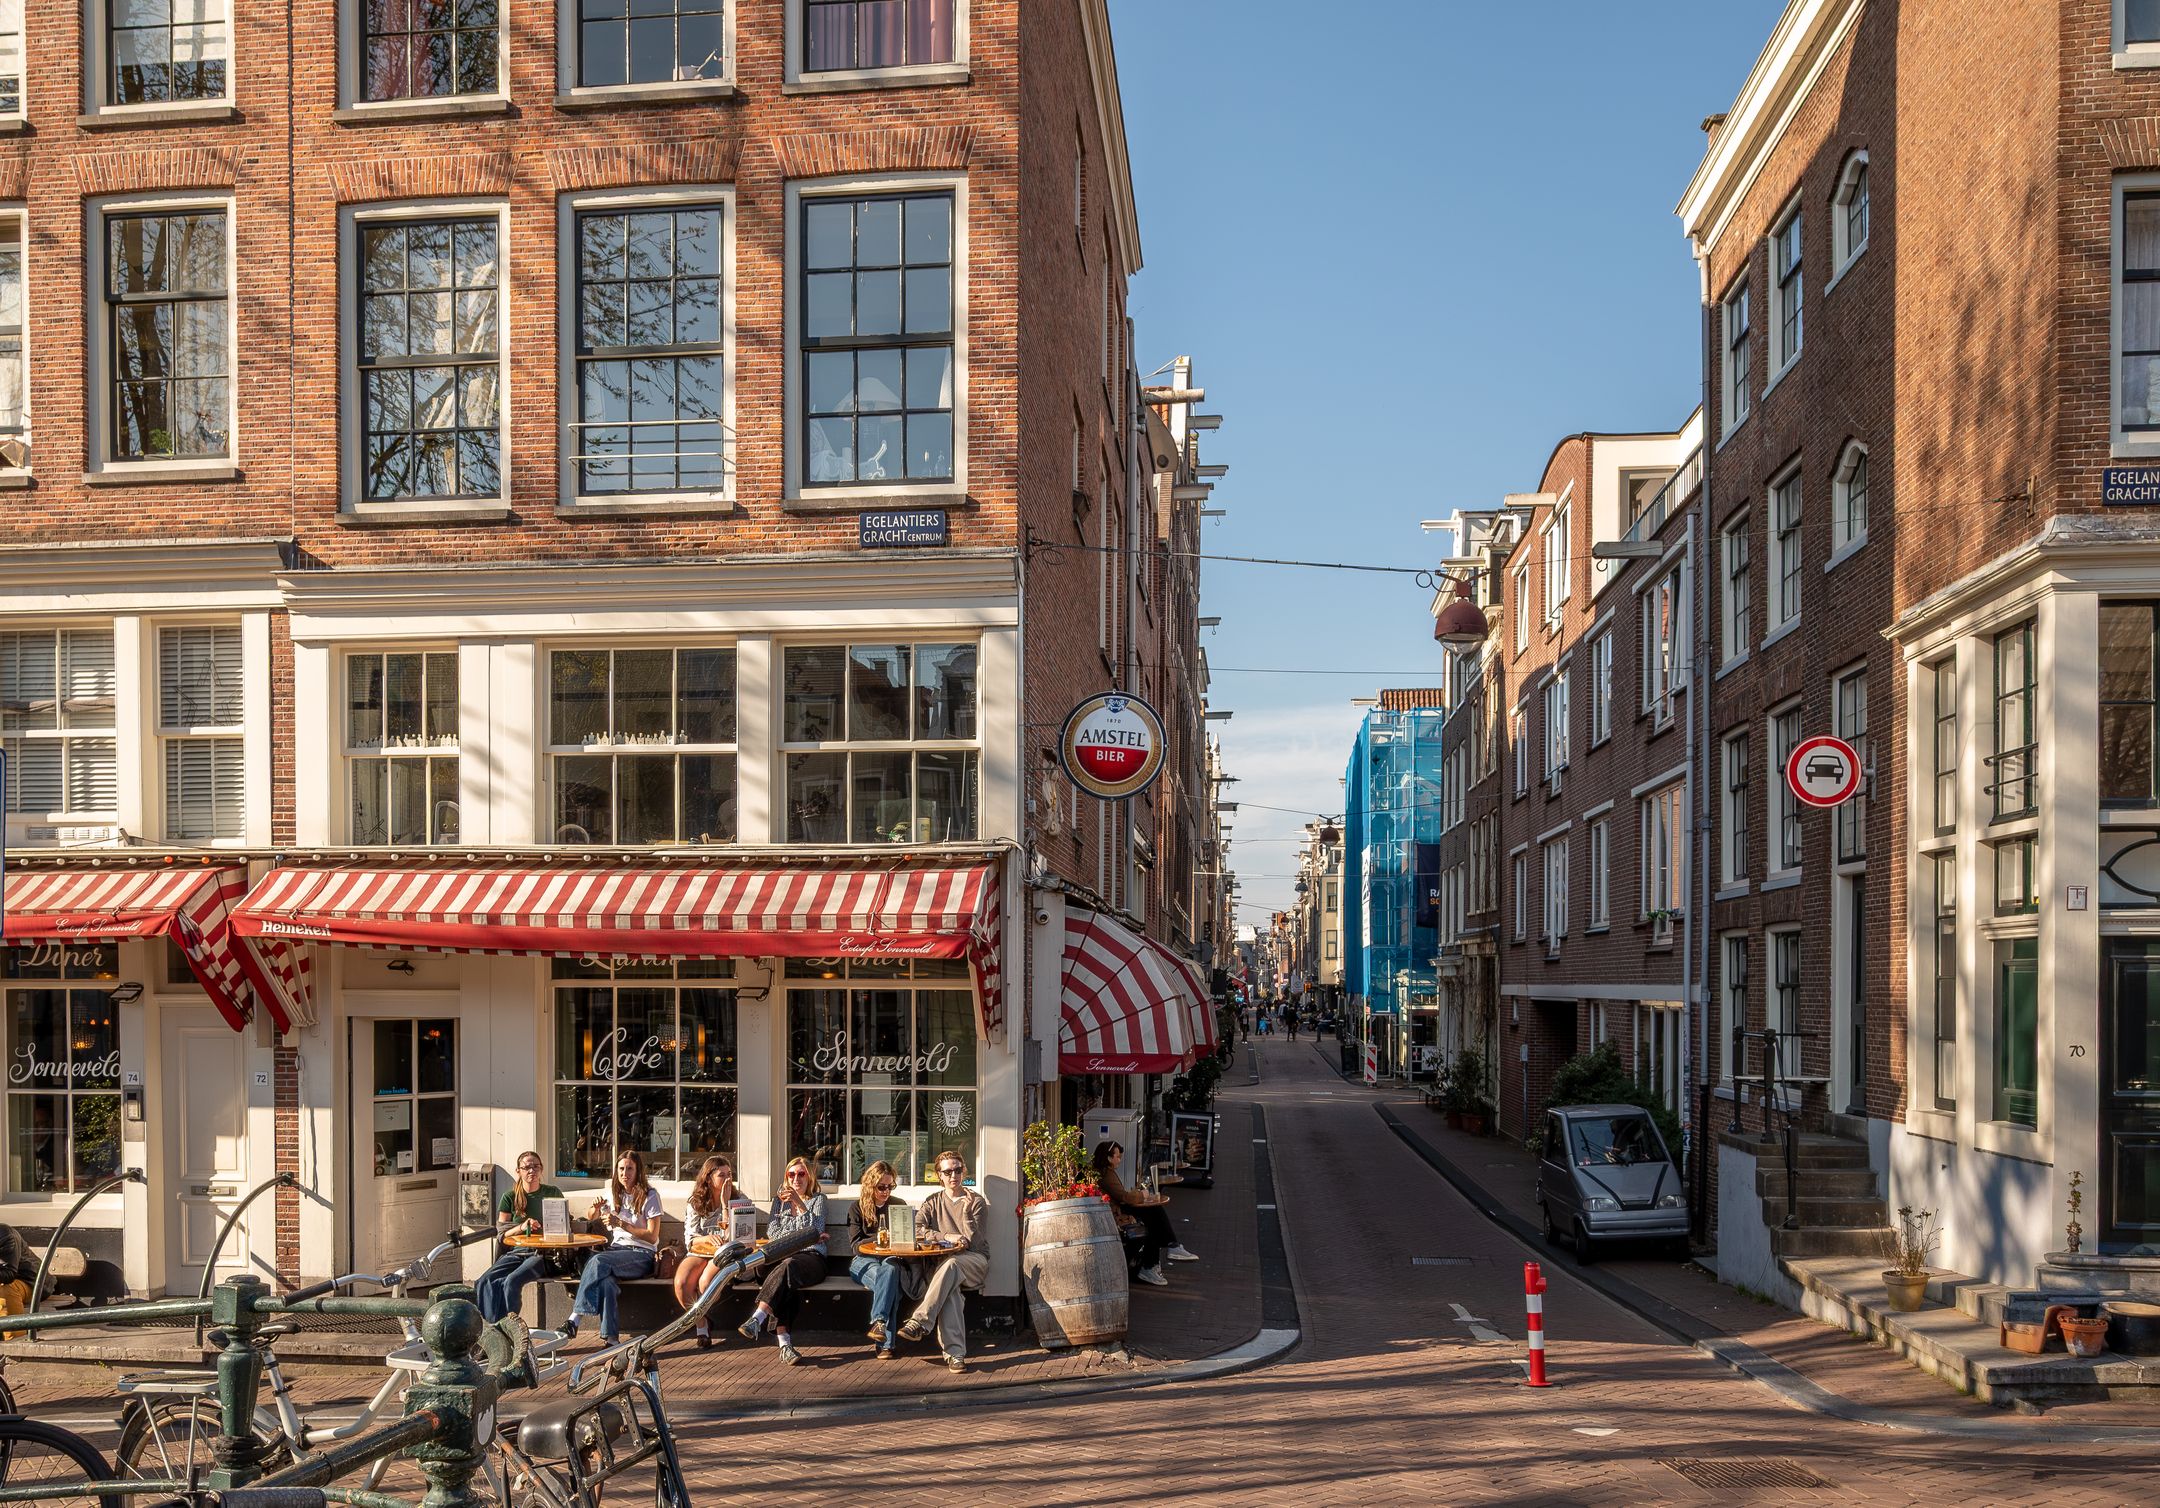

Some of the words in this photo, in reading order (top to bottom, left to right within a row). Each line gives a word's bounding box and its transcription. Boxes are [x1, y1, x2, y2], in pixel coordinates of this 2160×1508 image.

[2110, 471, 2160, 485] EGELAN
[2106, 487, 2159, 500] GRACHT
[865, 514, 939, 528] EGELANTIERS
[862, 529, 907, 543] GRACHT
[907, 533, 942, 542] CENTRUM
[1079, 728, 1145, 747] AMSTEL
[1096, 750, 1125, 762] BIER
[90, 918, 143, 932] Sonneveld
[261, 920, 332, 936] Heineken
[876, 937, 936, 954] Sonneveld
[813, 1030, 959, 1072] Sonneveld
[2069, 1045, 2086, 1057] 70
[1085, 1058, 1139, 1072] Sonneveld
[128, 1074, 138, 1082] 74
[256, 1074, 266, 1083] 72
